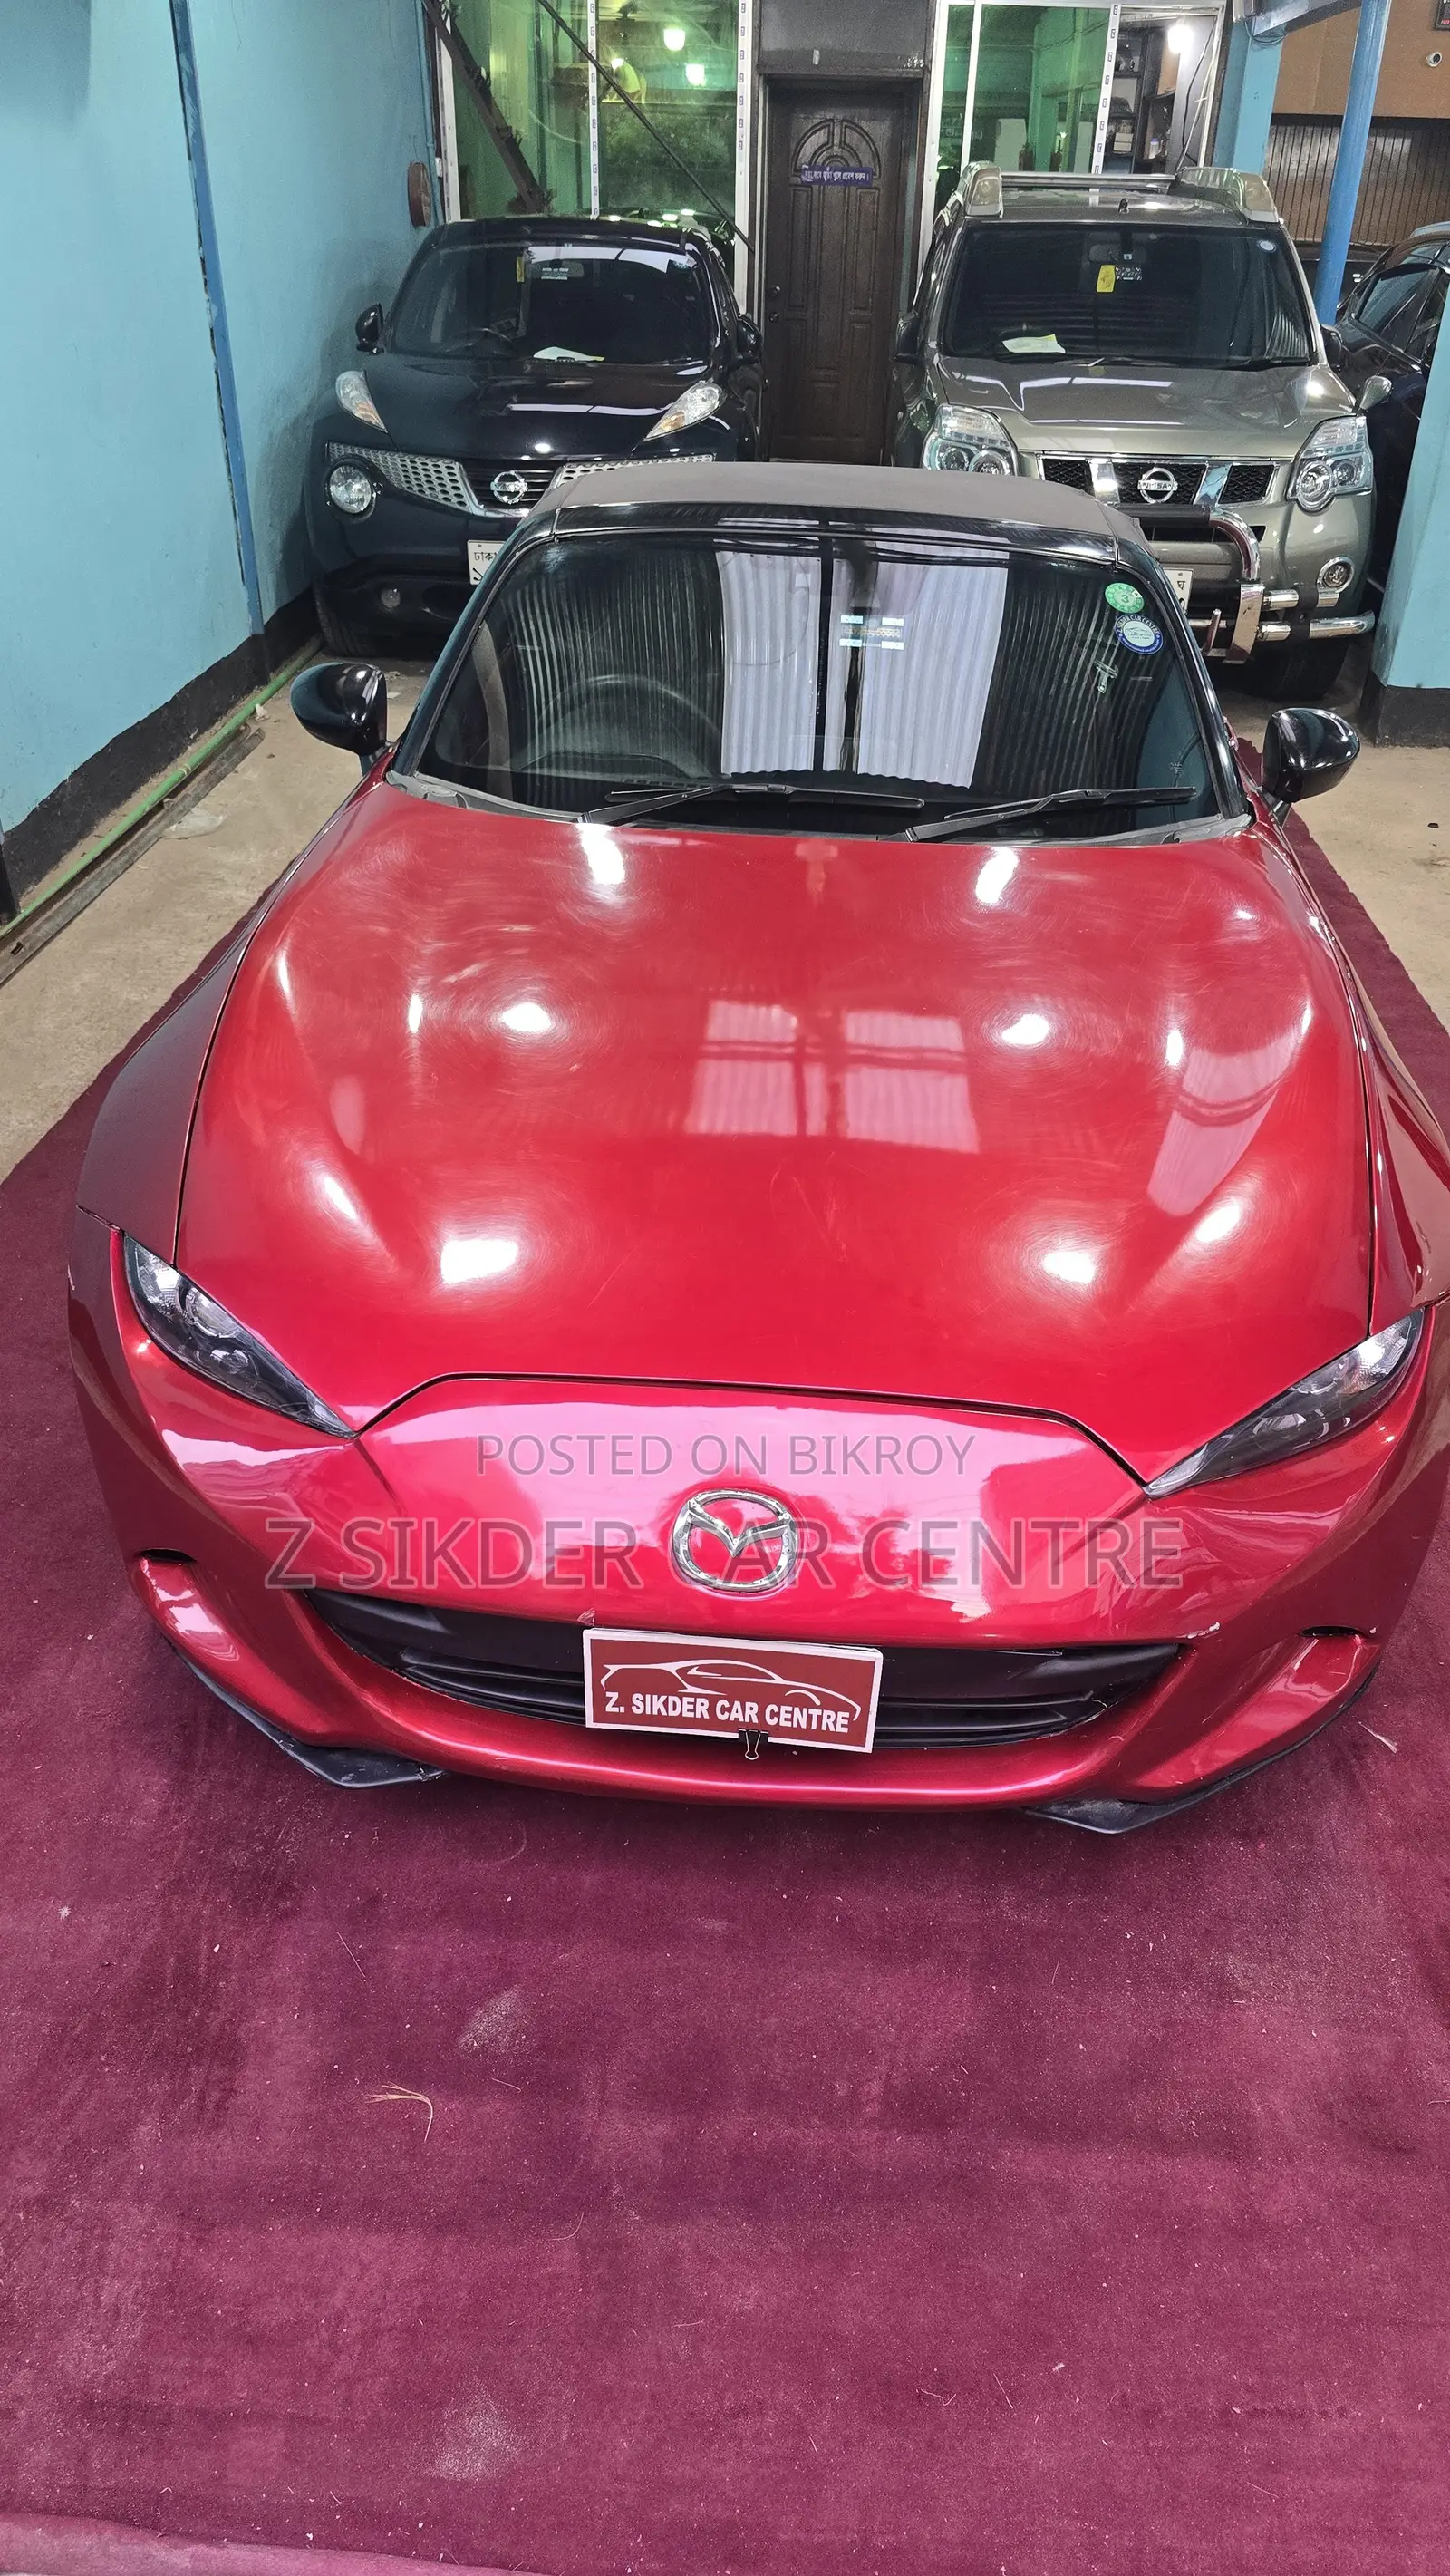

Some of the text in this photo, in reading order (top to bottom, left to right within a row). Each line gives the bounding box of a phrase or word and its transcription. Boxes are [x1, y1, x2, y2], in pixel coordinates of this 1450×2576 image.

[604, 1691, 851, 1733] Z. SIKDER CAR CENTRE
